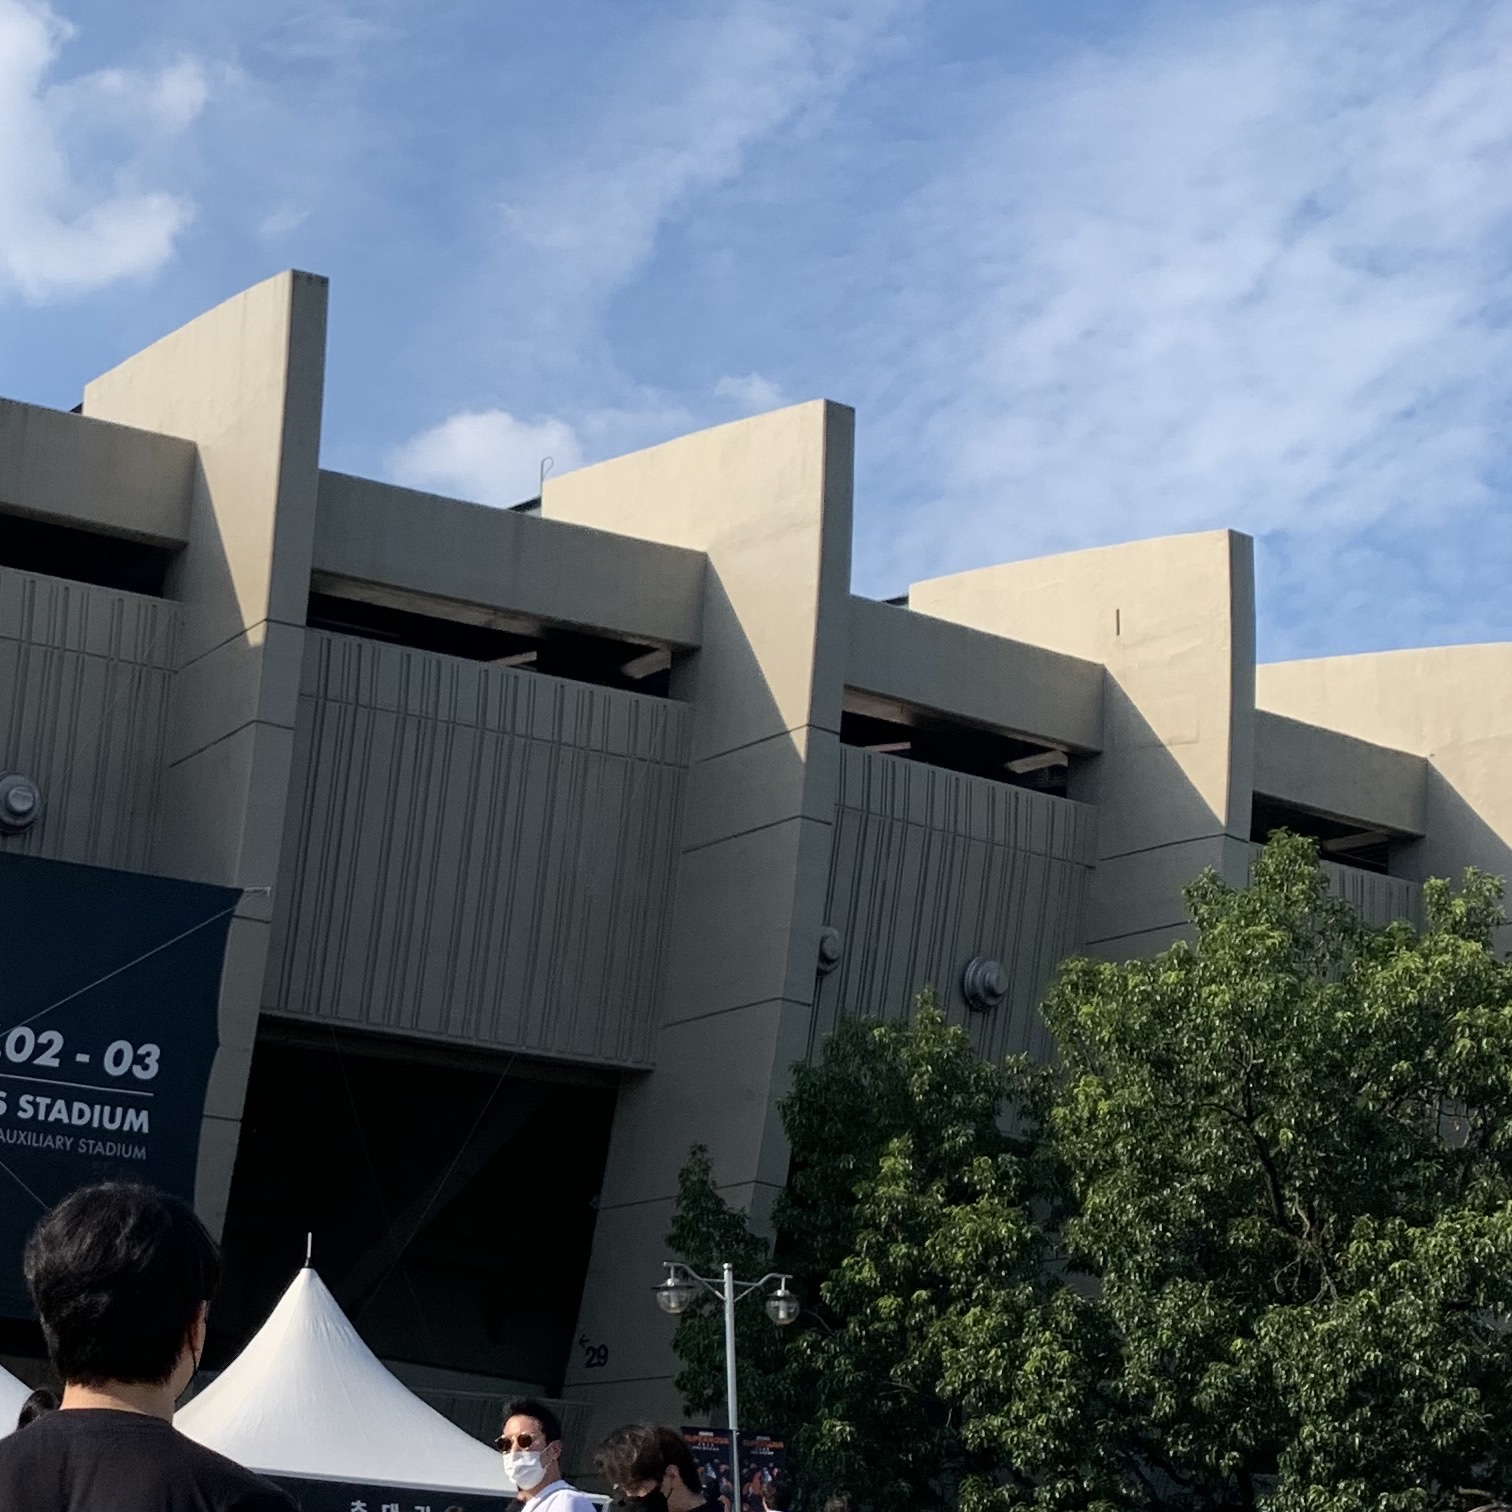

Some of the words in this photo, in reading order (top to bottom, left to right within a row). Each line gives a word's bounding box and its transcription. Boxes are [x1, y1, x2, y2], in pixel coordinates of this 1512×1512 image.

[103, 1039, 161, 1080] 03
[17, 1095, 149, 1134] STADIUM
[77, 1139, 147, 1160] STADIUM
[585, 1344, 609, 1369] 29
